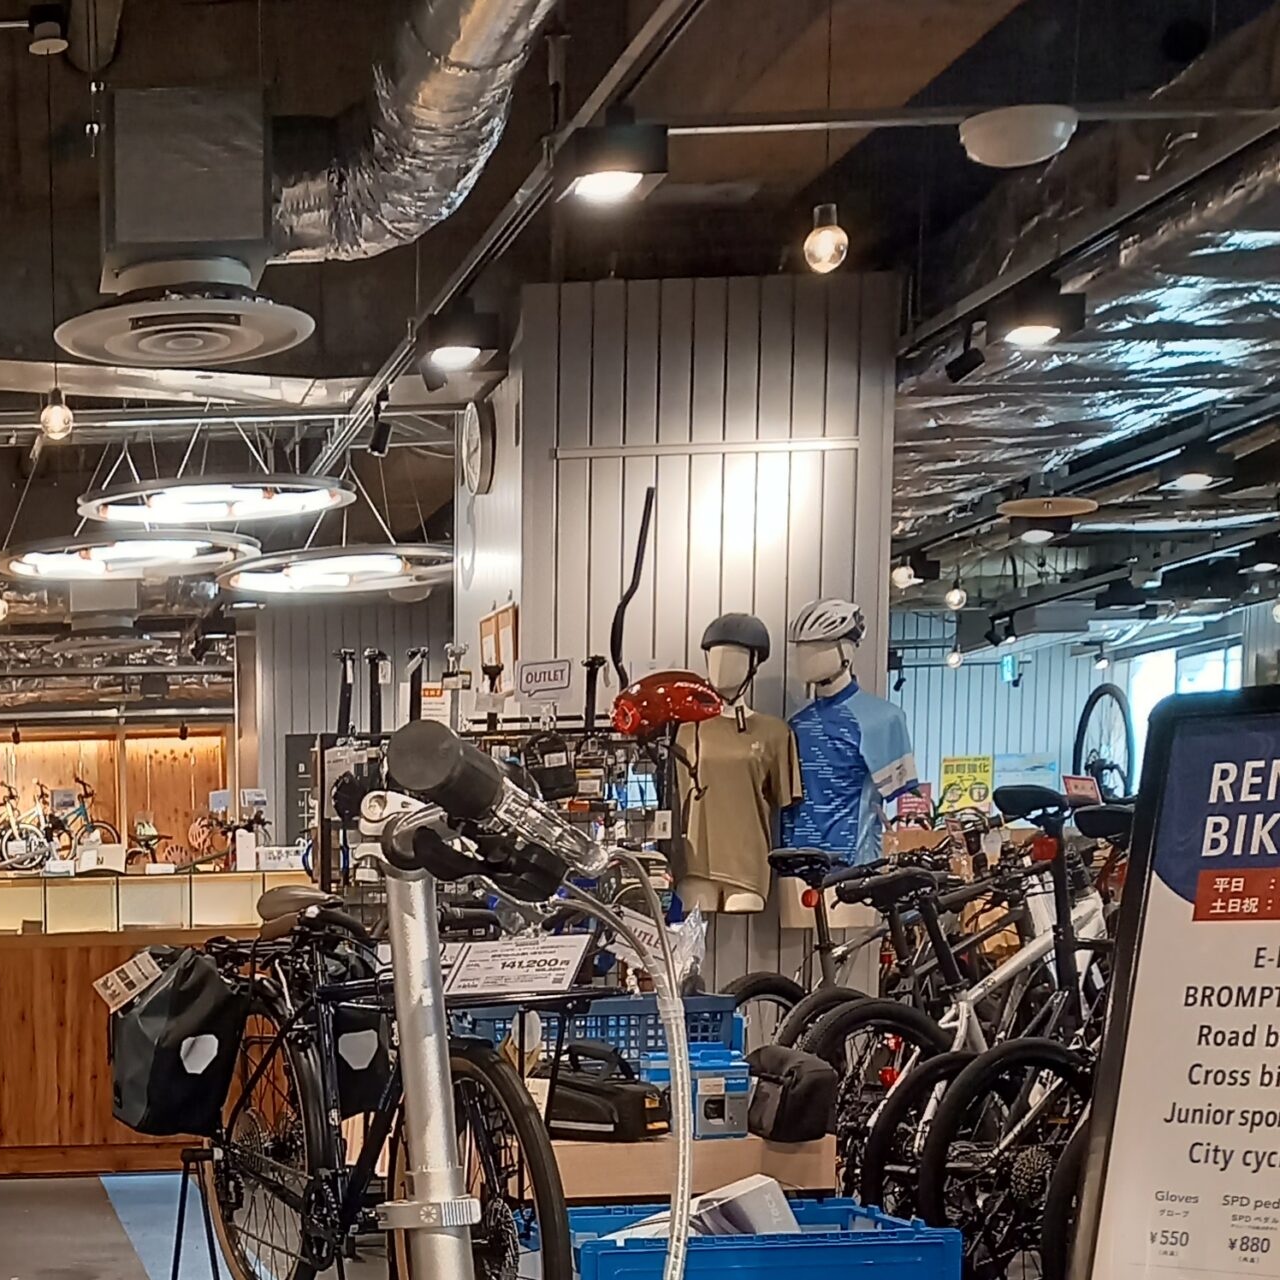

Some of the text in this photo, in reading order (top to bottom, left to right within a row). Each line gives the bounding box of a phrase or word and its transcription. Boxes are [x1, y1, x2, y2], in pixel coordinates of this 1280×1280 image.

[525, 668, 565, 684] OUTLET
[1213, 877, 1245, 893] 平日
[1209, 897, 1259, 913] 土日祝
[1254, 946, 1280, 968] E-
[1196, 1024, 1257, 1047] Road
[1187, 1063, 1251, 1086] Cross
[1163, 1102, 1235, 1126] Junior
[1188, 1142, 1234, 1171] City
[1154, 1190, 1199, 1204] Gloves
[1222, 1194, 1251, 1207] SPD
[1150, 1230, 1190, 1247] ¥550
[1228, 1235, 1271, 1253] ¥880
